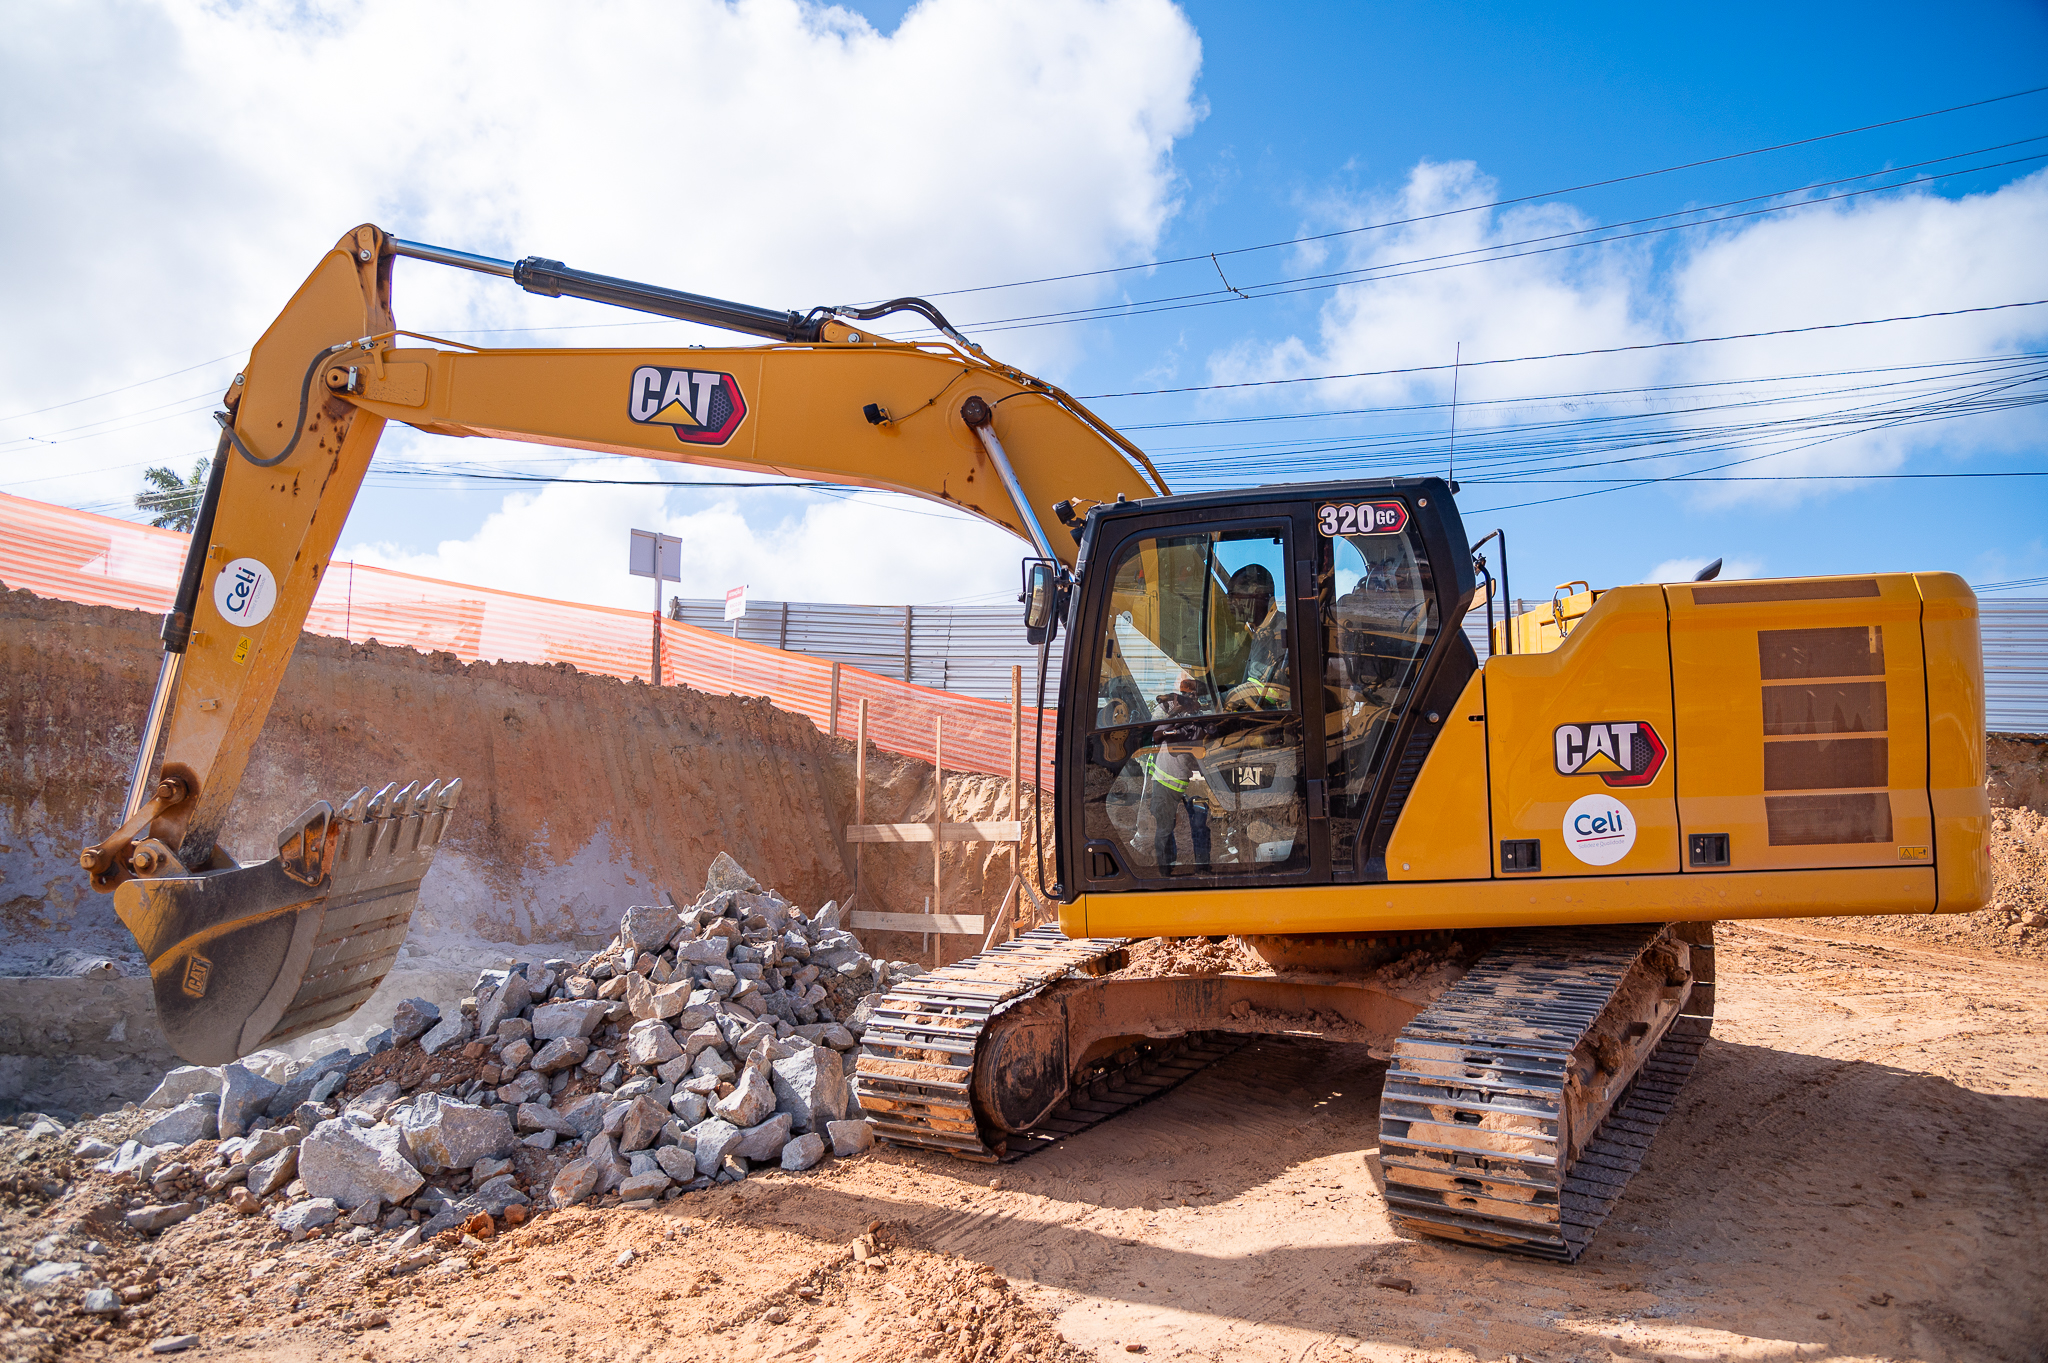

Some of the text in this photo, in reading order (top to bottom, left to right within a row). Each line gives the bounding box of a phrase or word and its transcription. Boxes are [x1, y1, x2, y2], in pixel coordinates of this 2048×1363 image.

[631, 367, 720, 427] CAT
[1320, 504, 1396, 534] 320 GC
[226, 566, 256, 612] Celi
[1556, 723, 1637, 774] CAT
[1574, 810, 1623, 835] Celi
[1600, 839, 1625, 848] Qualidade
[188, 961, 207, 990] CAT
